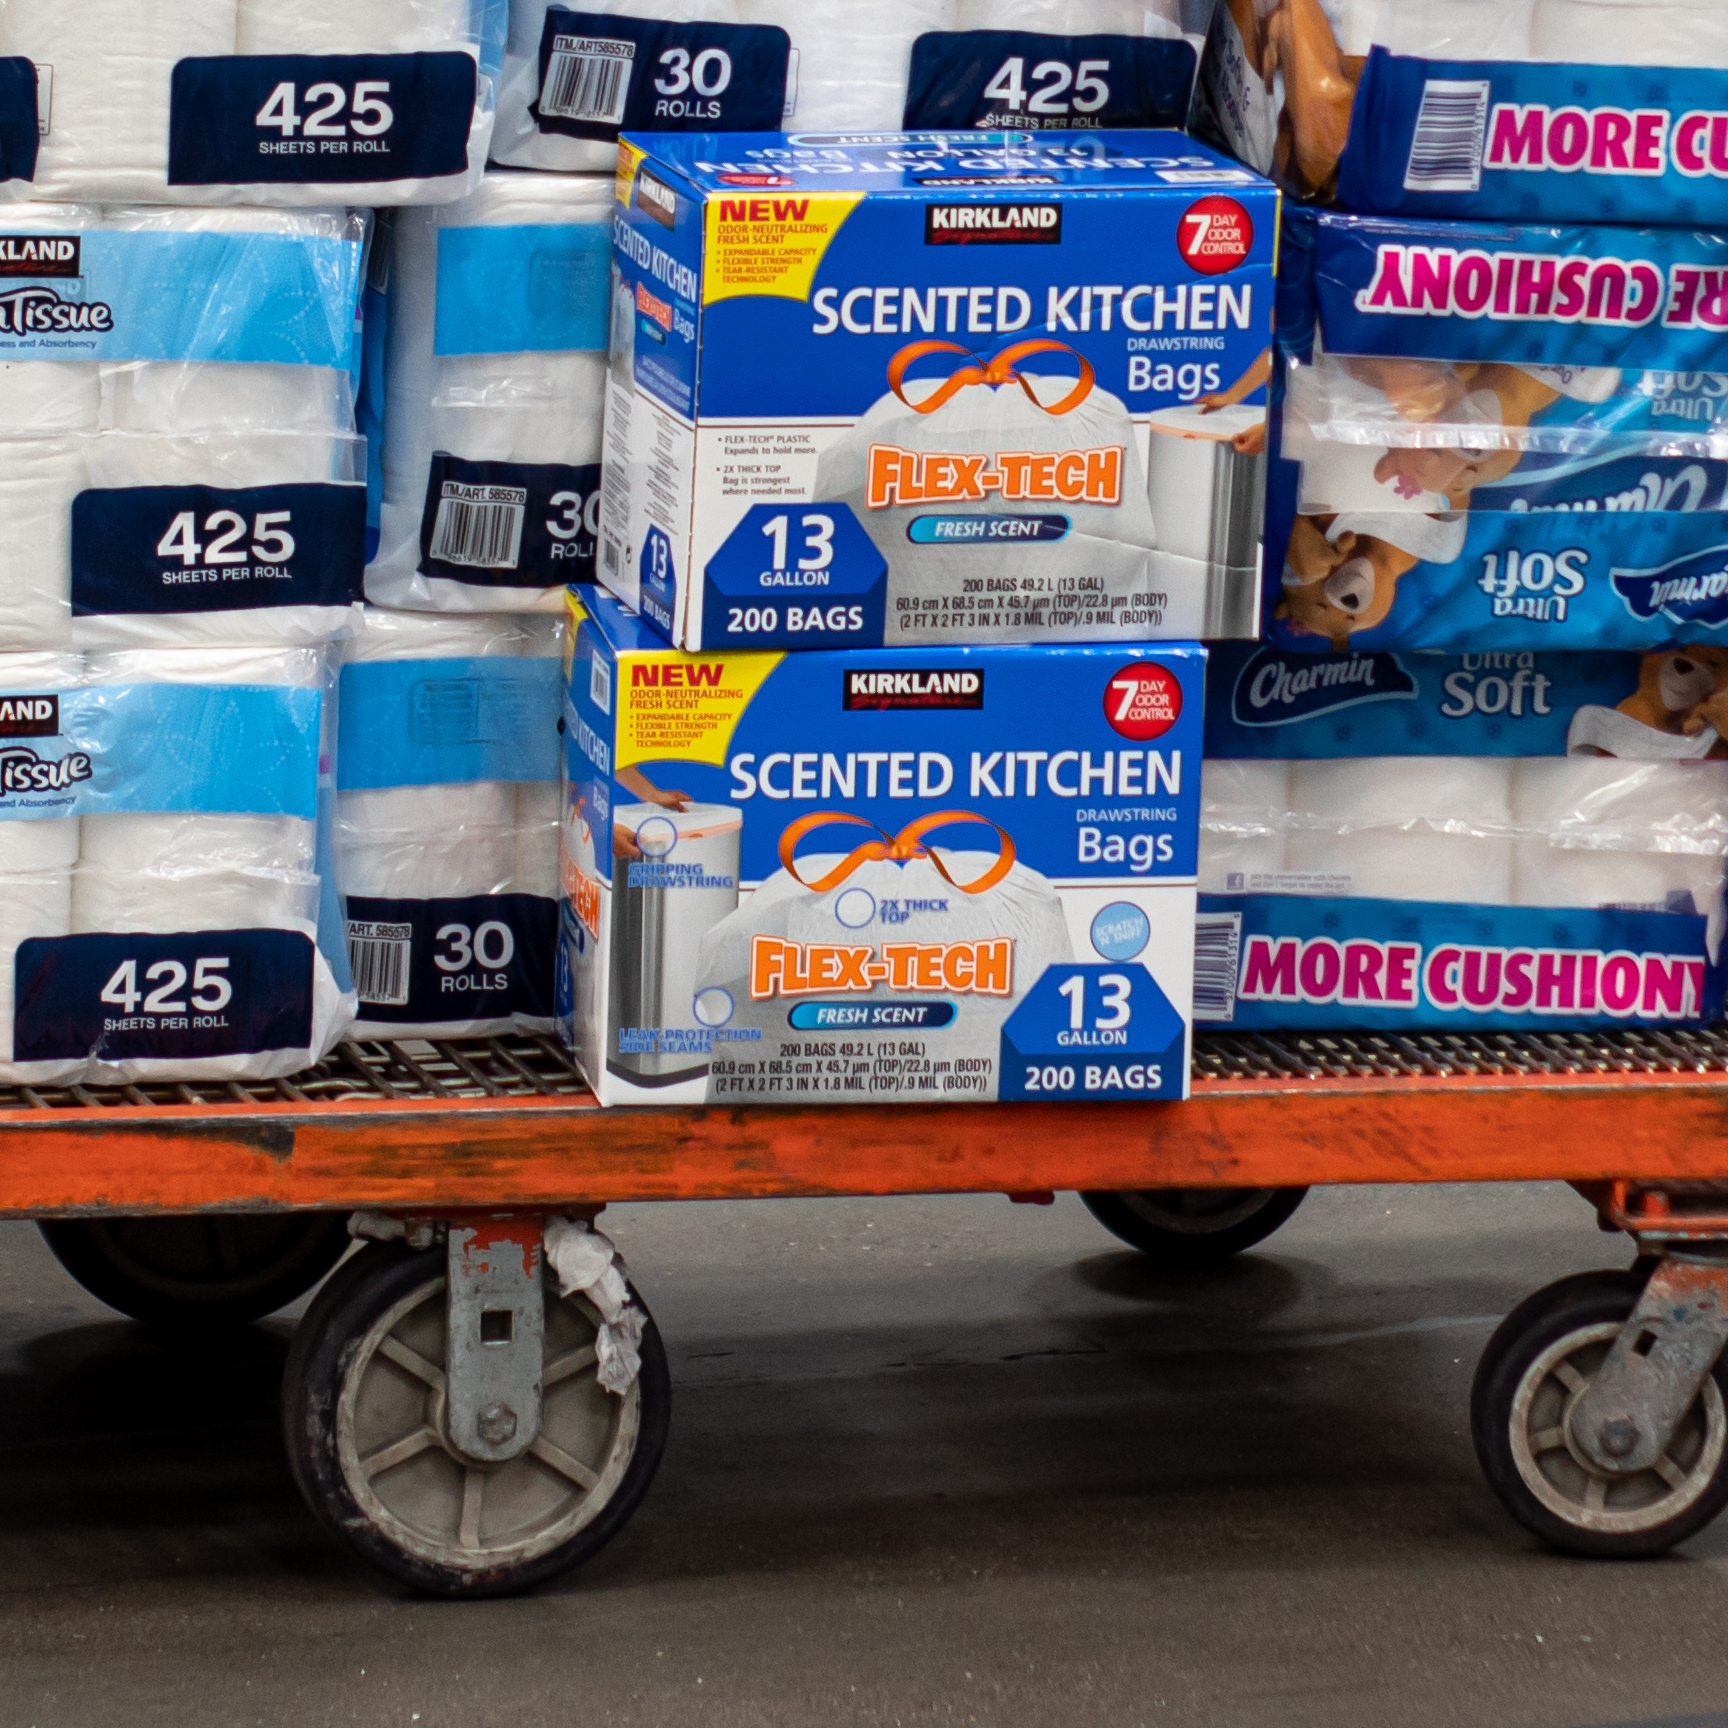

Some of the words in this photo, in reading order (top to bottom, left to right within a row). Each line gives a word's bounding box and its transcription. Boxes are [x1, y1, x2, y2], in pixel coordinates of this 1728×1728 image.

[984, 57, 1111, 113] 425
[255, 80, 394, 138] 425
[258, 140, 316, 154] SHEETS
[319, 140, 350, 153] PER
[352, 139, 391, 153] ROLL
[1486, 104, 1669, 174] MORE
[719, 199, 809, 222] NEW
[932, 207, 1057, 229] KIRKLAND
[1358, 245, 1662, 326] CUSHIONY
[812, 286, 1032, 335] SCENTED
[1046, 284, 1252, 333] KITCHEN
[1127, 336, 1225, 351] DRAWSTRING
[1128, 355, 1221, 401] Bags
[866, 442, 1124, 510] FLEX-TECH
[156, 510, 296, 565] 425
[761, 513, 835, 571] 13
[934, 522, 984, 537] FRESH
[988, 520, 1042, 536] SCENT
[760, 571, 830, 586] GALLON
[1478, 548, 1590, 597] Soft
[727, 607, 778, 632] 200
[787, 606, 863, 631] BAGS
[630, 689, 743, 699] ODOR-NEUTRALIZING
[631, 664, 724, 687] NEW
[851, 673, 979, 694] KIRKLAND
[1439, 671, 1553, 718] Soft
[630, 700, 663, 709] FRESH
[666, 700, 699, 709] SCENT
[1112, 680, 1138, 721] 7
[1140, 681, 1166, 693] DAY
[1128, 708, 1175, 721] CONTROL
[1135, 694, 1169, 706] ODOR
[729, 752, 955, 800] SCENTED
[969, 749, 1181, 798] KITCHEN
[1076, 808, 1177, 822] DRAWSTRING
[1078, 827, 1173, 872] Bags
[99, 956, 232, 1014] 425
[748, 933, 1015, 1002] FLEX-TECH
[1237, 936, 1421, 1007] MORE
[816, 1007, 868, 1024] FRESH
[872, 1007, 928, 1023] SCENT
[1058, 974, 1132, 1030] 13
[1056, 1030, 1127, 1045] GALLON
[1024, 1066, 1075, 1090] 200
[1084, 1065, 1162, 1089] BAGS
